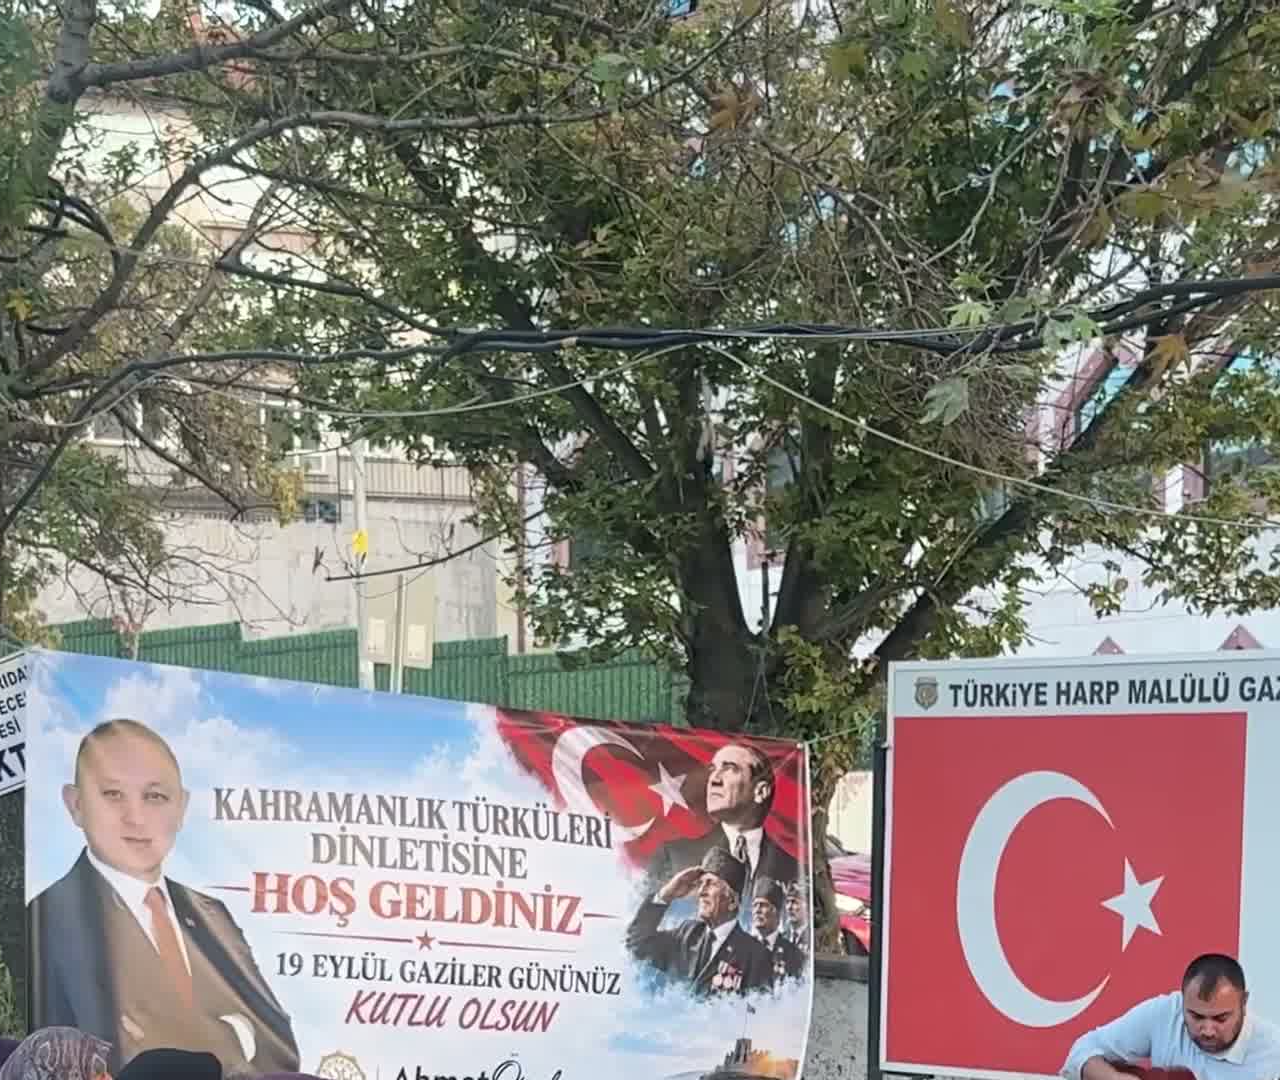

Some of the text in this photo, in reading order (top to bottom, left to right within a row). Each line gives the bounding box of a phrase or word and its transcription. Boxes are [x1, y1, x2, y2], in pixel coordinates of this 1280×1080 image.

[1055, 680, 1118, 706] HARP
[1128, 672, 1230, 705] MALÜLÜ
[213, 787, 614, 849] KAHRAMANLIK TÜRKÜLERİ
[310, 825, 528, 880] DİNLETİSİNE
[249, 871, 584, 936] HOŞ GELDİNİZ
[276, 952, 622, 996] 19 EYLÜL GAZİLER GÜNÜNÜZ
[344, 990, 560, 1033] KUTLU OLSUN
